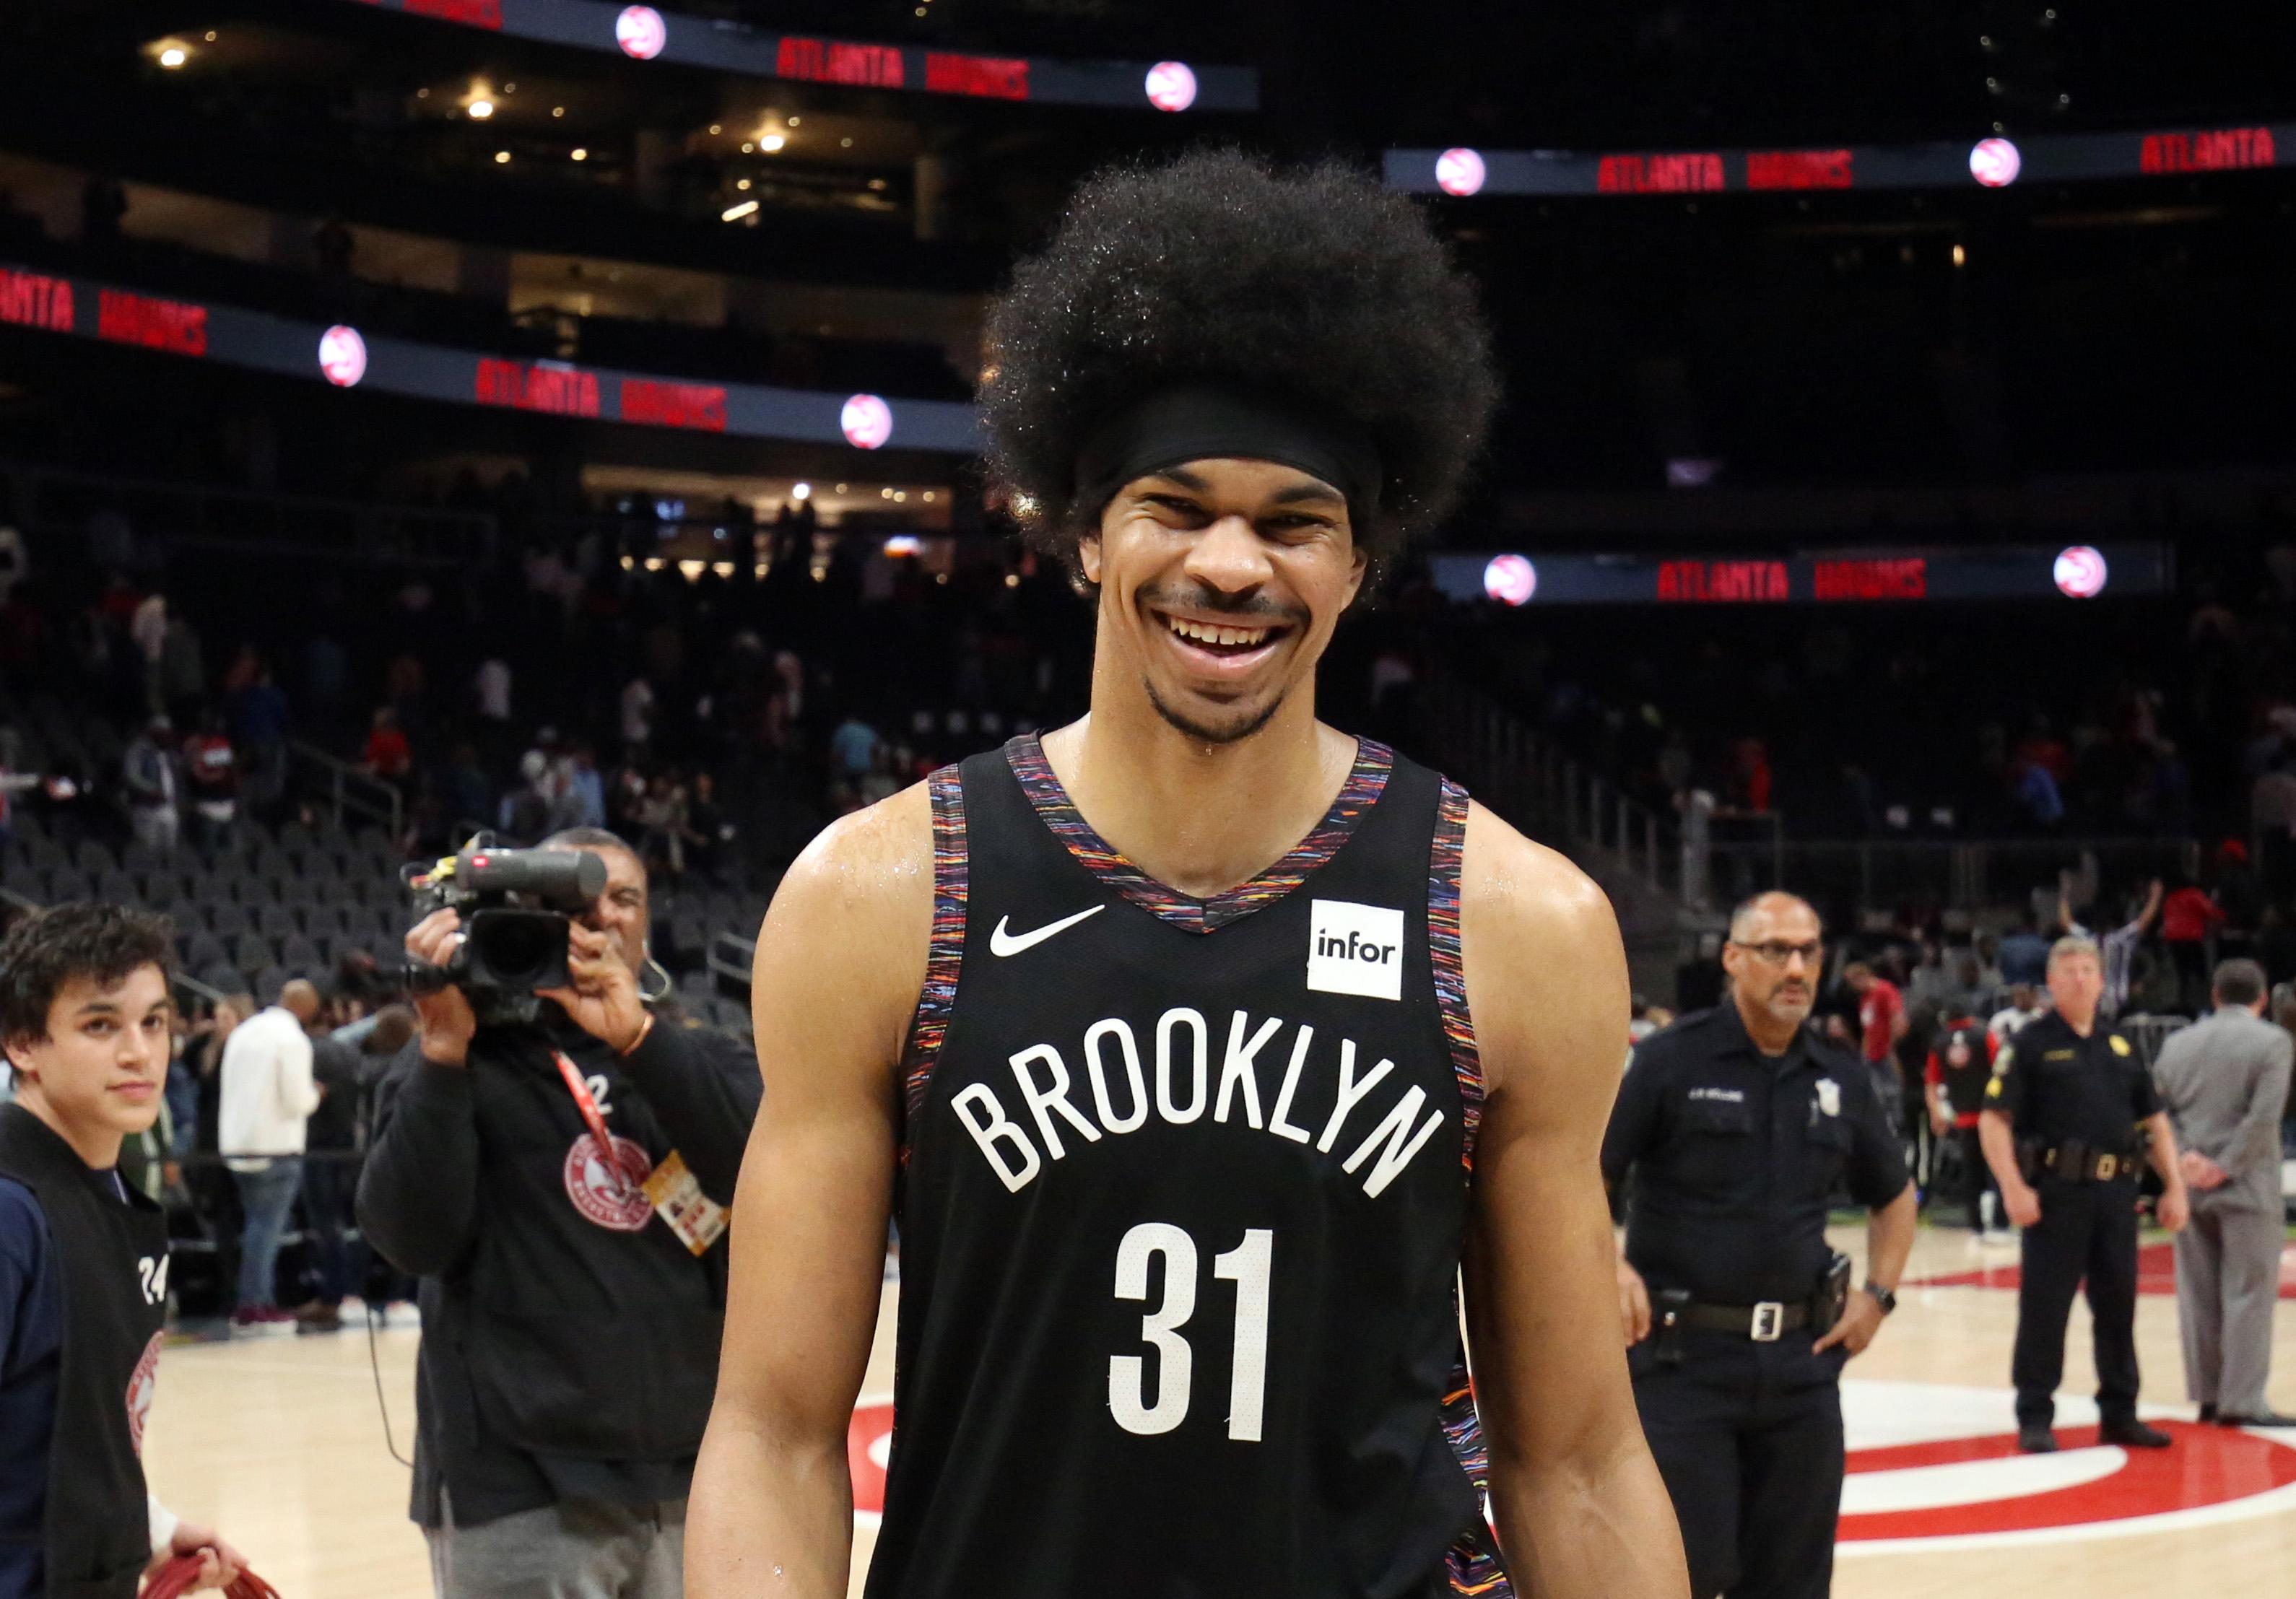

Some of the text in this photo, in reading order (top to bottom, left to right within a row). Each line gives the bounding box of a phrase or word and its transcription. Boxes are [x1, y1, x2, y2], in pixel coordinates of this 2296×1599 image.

[1597, 152, 1724, 193] ATLANTA
[2140, 126, 2274, 174] ATLANTA
[1657, 560, 1789, 601] ATLANTA
[1318, 928, 1396, 964] infor
[950, 1007, 1445, 1199] BROOKLYN
[138, 1253, 170, 1306] 24
[1108, 1221, 1273, 1442] 31
